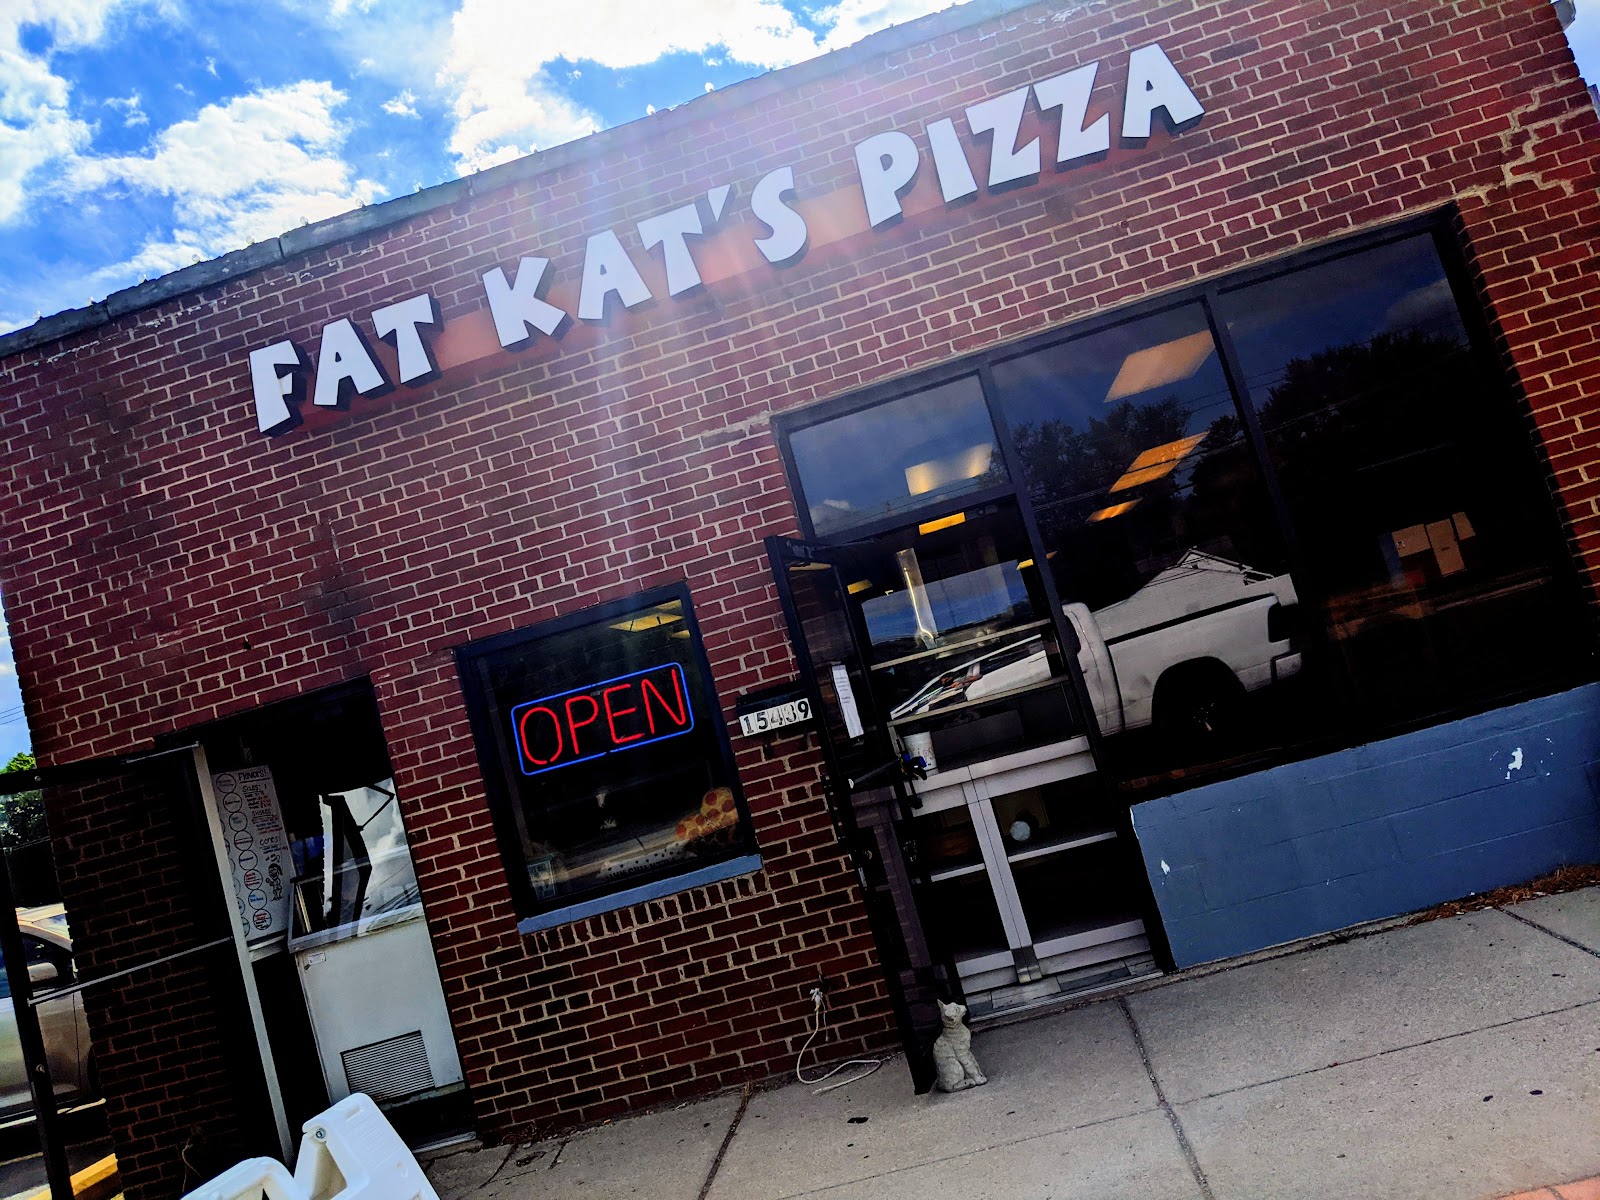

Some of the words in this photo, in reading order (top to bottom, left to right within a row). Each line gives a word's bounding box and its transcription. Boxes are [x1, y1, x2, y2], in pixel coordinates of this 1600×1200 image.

[248, 293, 436, 434] FAT
[482, 166, 808, 348] KAT'S
[854, 43, 1206, 229] PIZZA
[519, 668, 687, 766] OPEN
